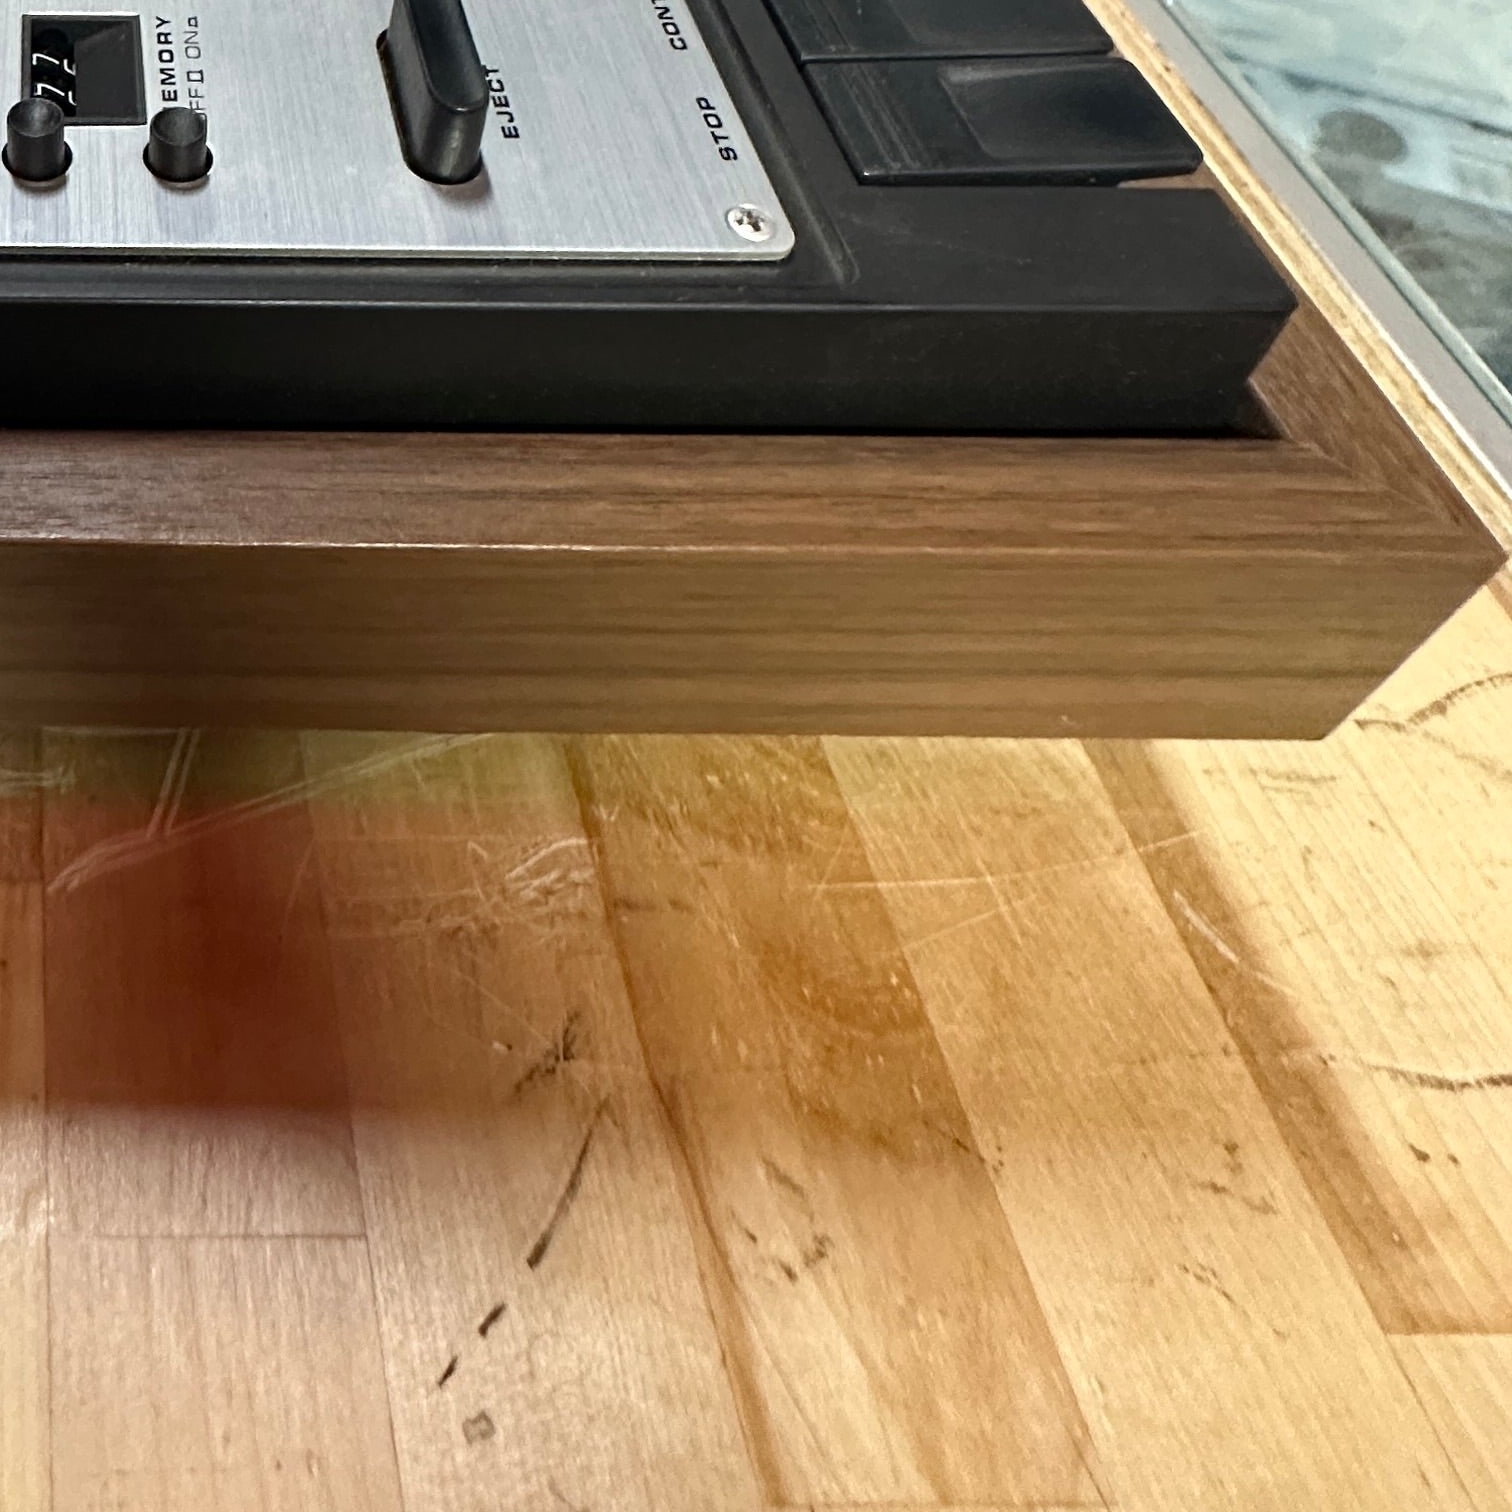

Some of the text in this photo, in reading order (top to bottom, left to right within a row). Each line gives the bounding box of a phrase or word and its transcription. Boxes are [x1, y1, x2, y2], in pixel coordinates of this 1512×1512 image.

[155, 15, 178, 109] EMORY
[483, 65, 521, 139] EJECT
[695, 96, 738, 162] STOP
